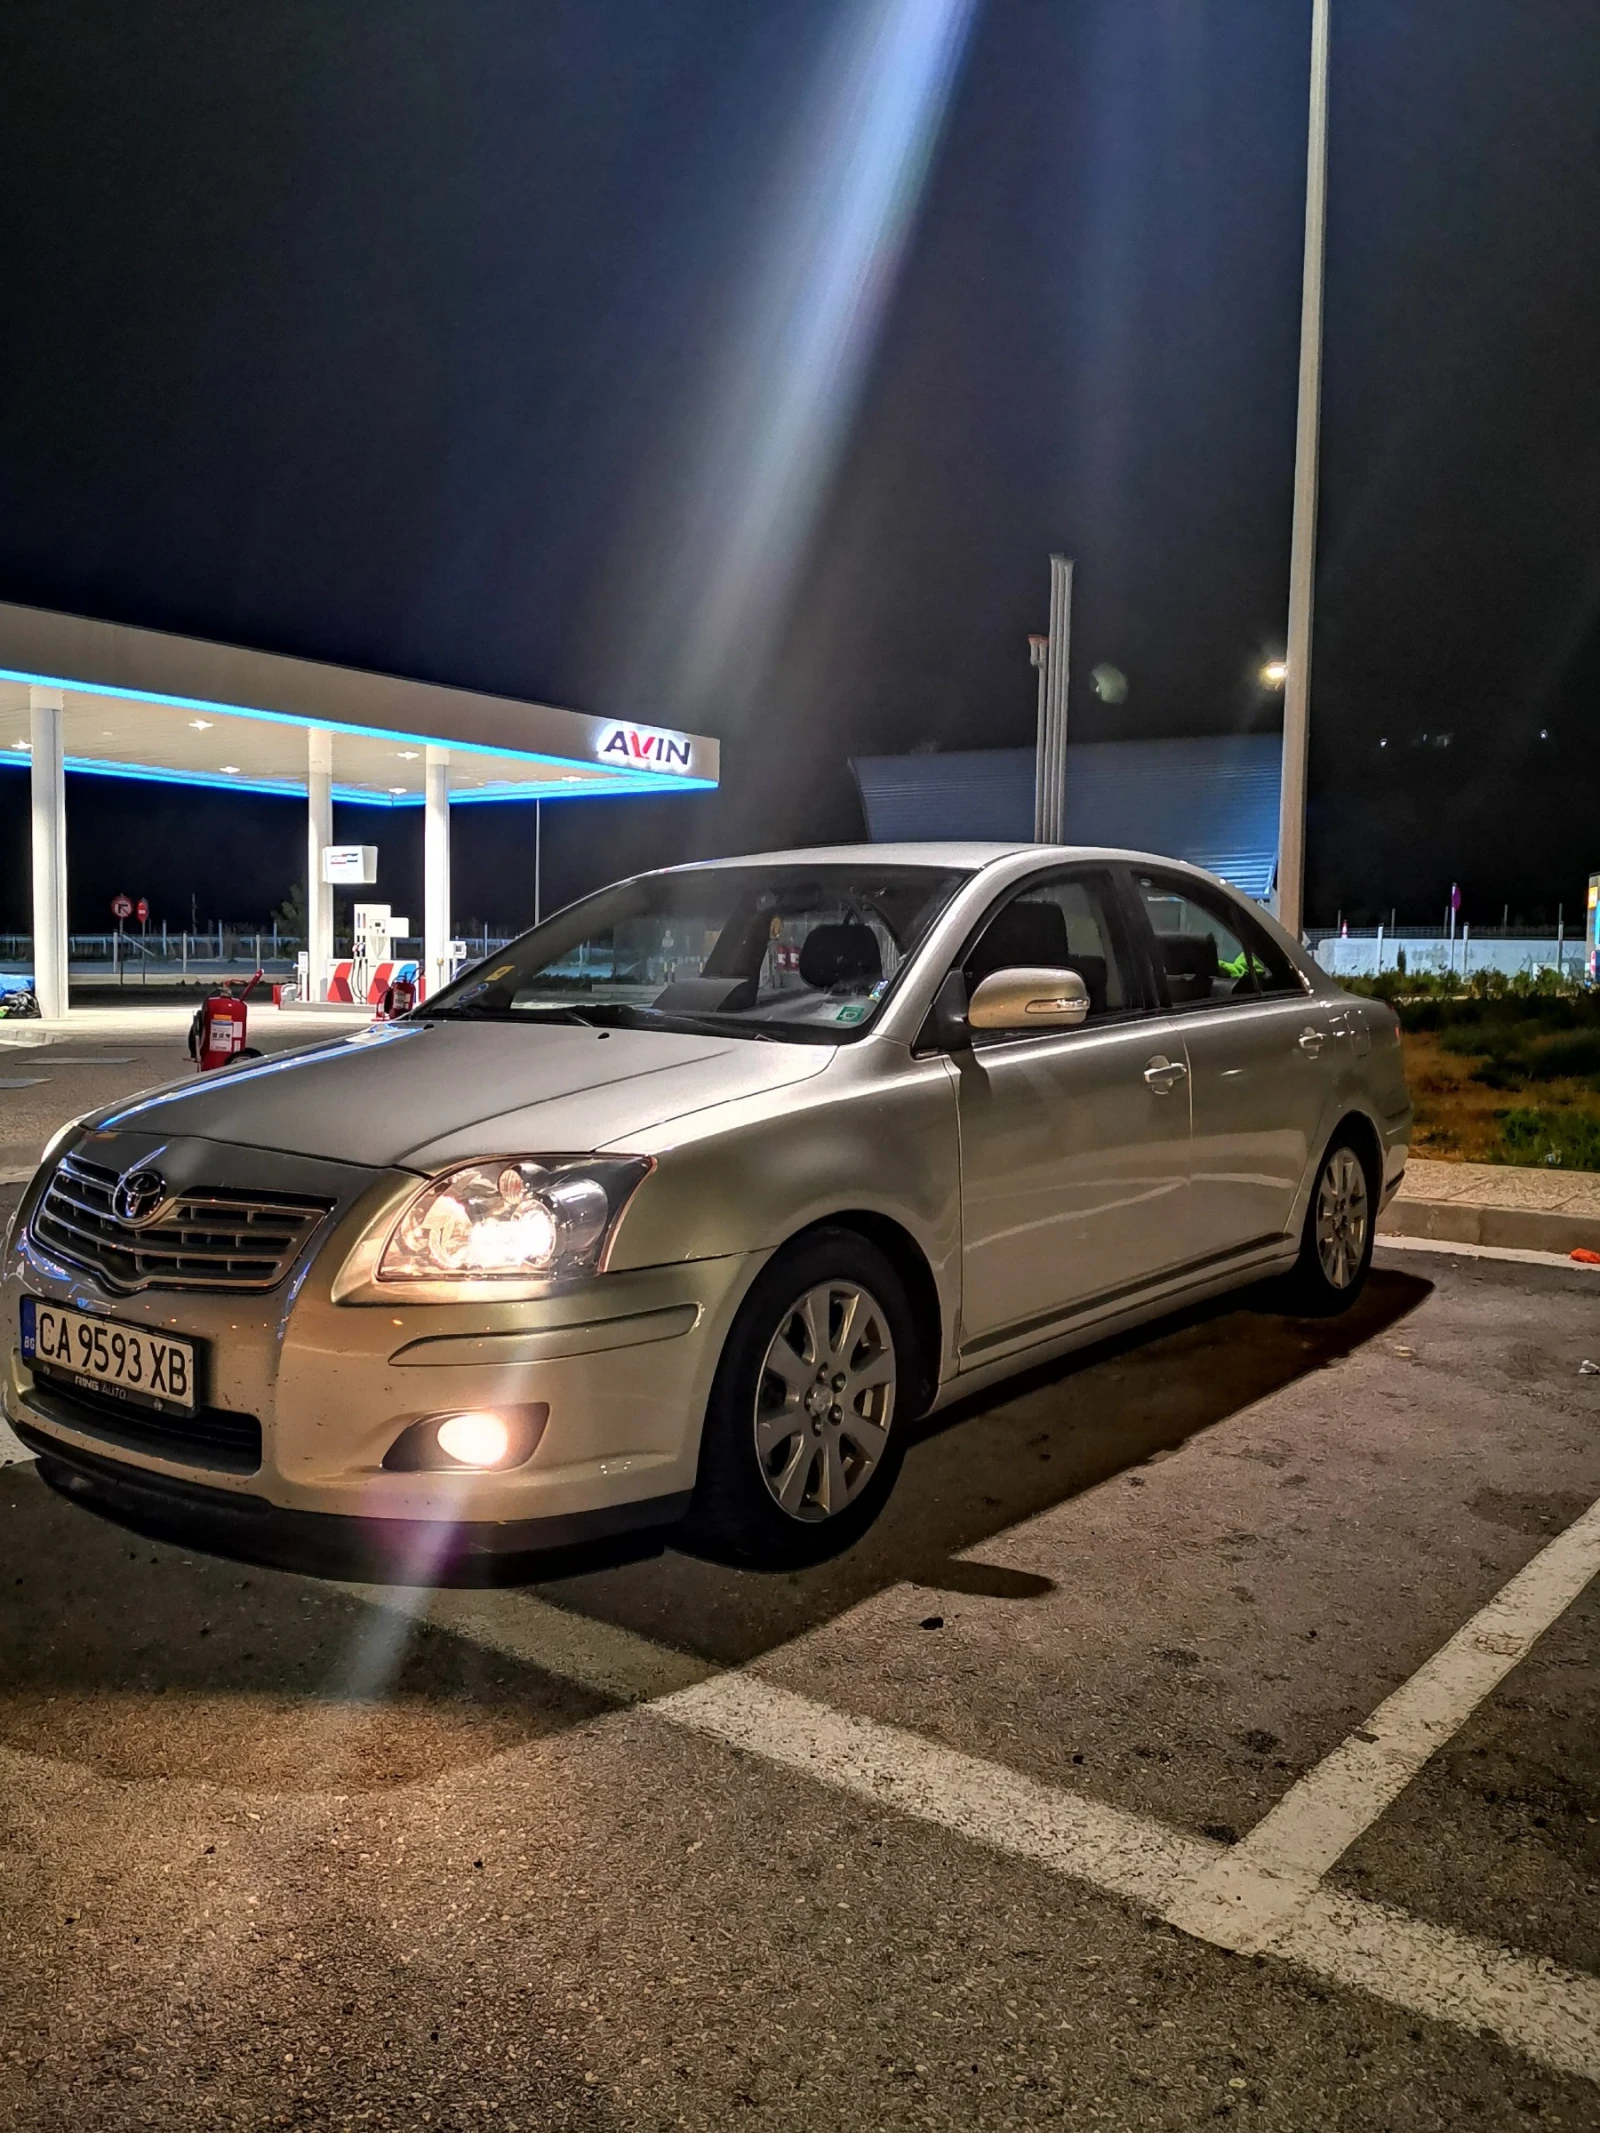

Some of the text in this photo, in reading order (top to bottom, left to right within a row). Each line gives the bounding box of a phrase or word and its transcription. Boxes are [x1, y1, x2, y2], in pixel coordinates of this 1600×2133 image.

[603, 731, 691, 765] AVIN
[24, 1336, 36, 1350] BG
[39, 1312, 187, 1397] CA 9593 XB
[74, 1375, 127, 1400] RING AUTO
